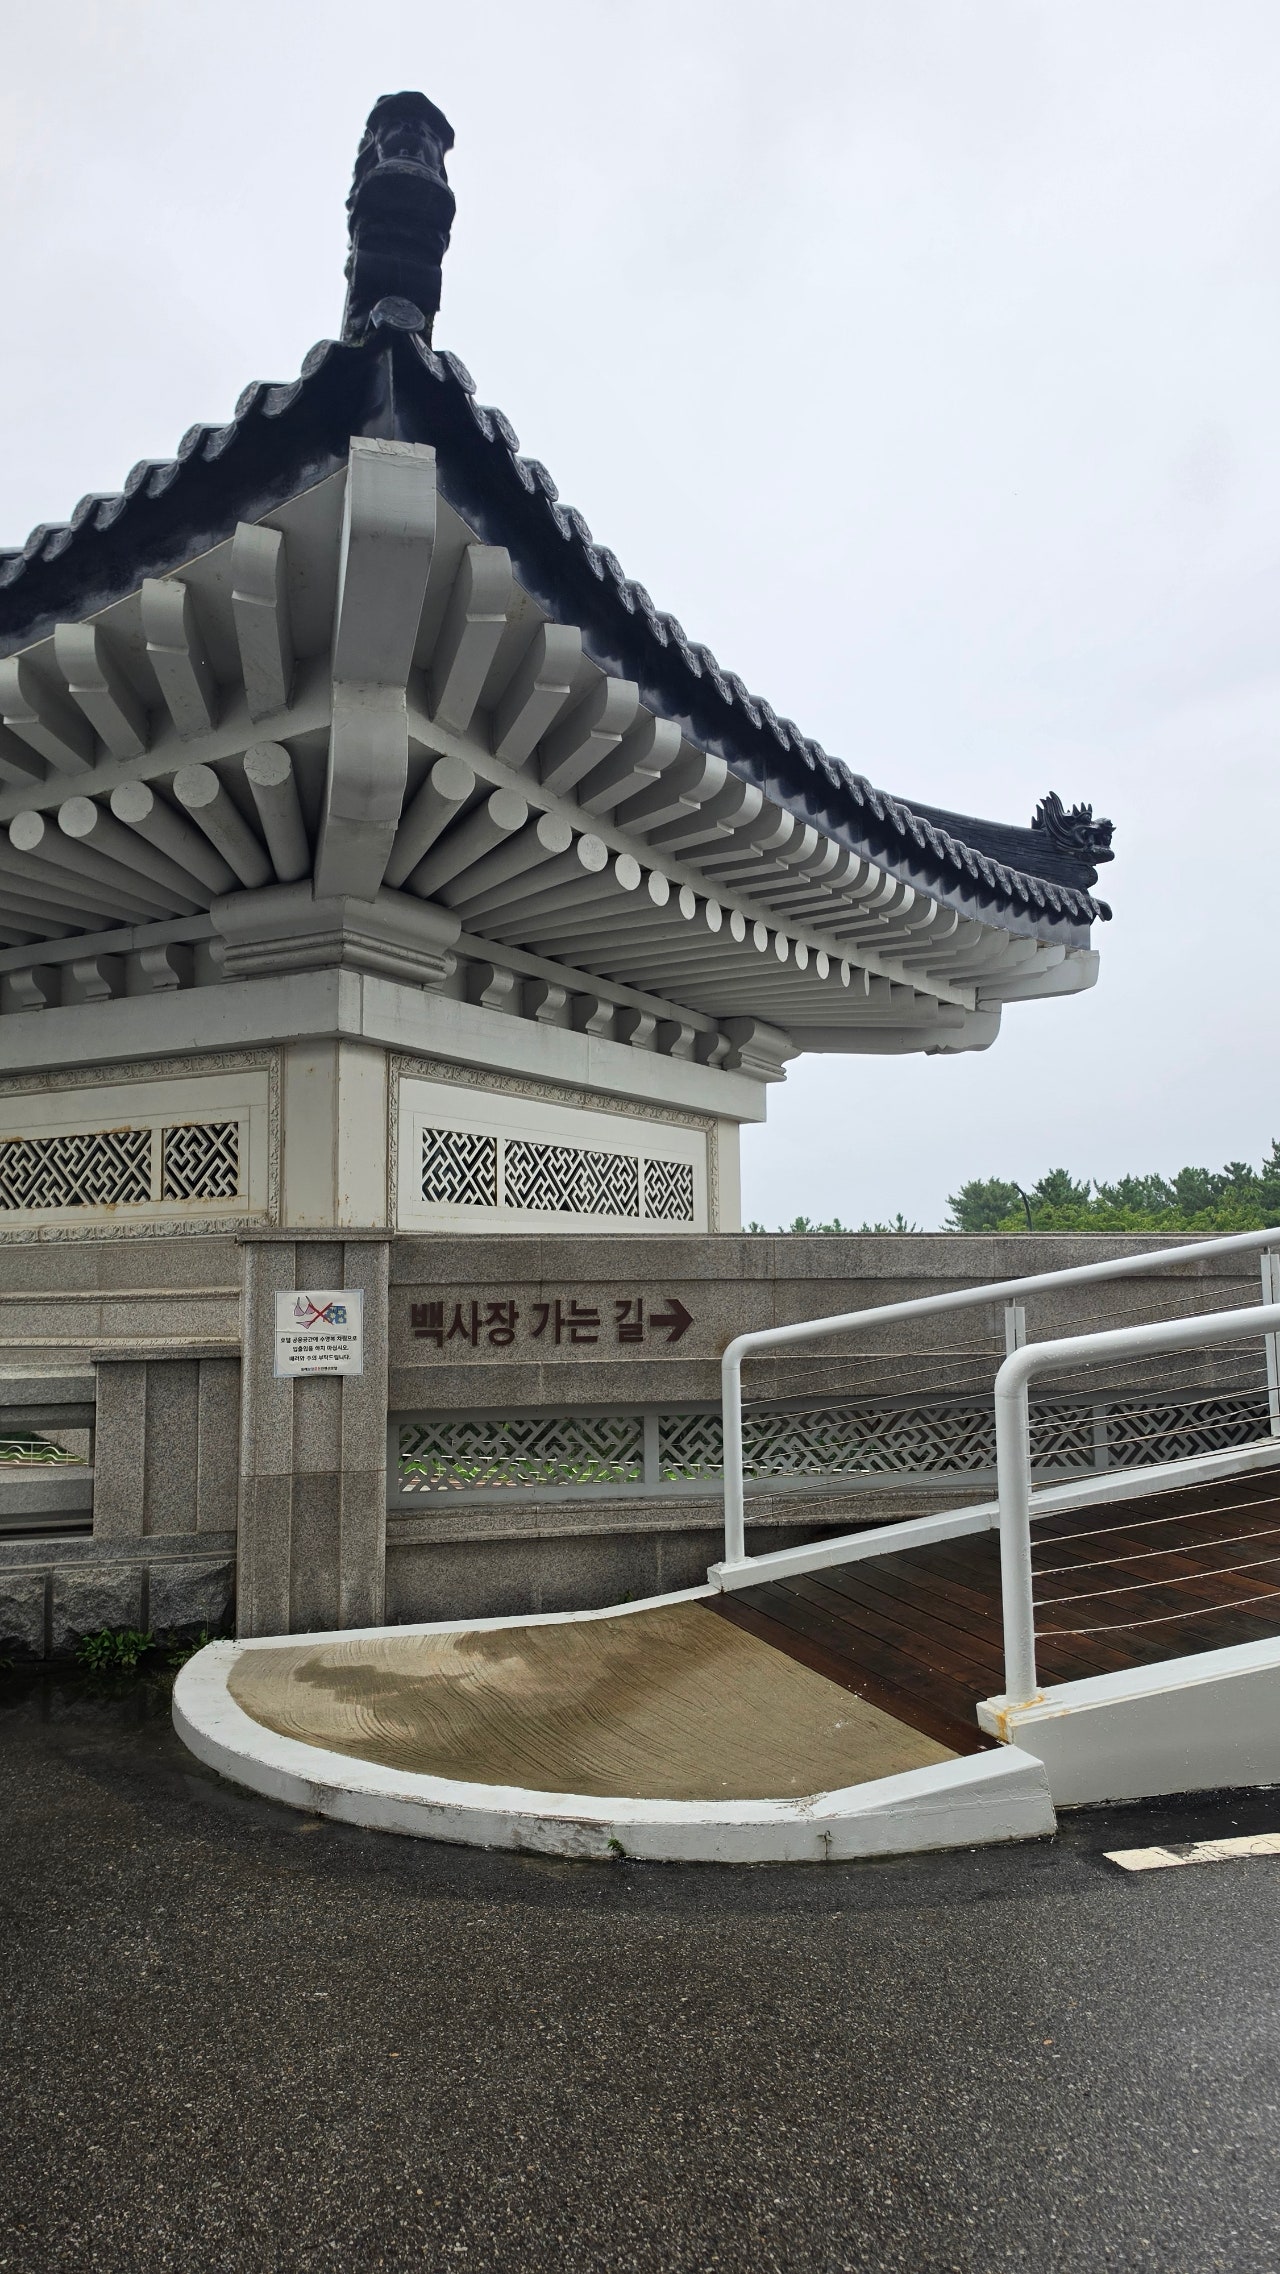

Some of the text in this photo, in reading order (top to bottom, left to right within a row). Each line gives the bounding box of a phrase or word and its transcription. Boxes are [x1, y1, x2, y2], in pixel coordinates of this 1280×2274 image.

[411, 1299, 644, 1348] 백사장 가는 길
[320, 1335, 335, 1343] 수영복
